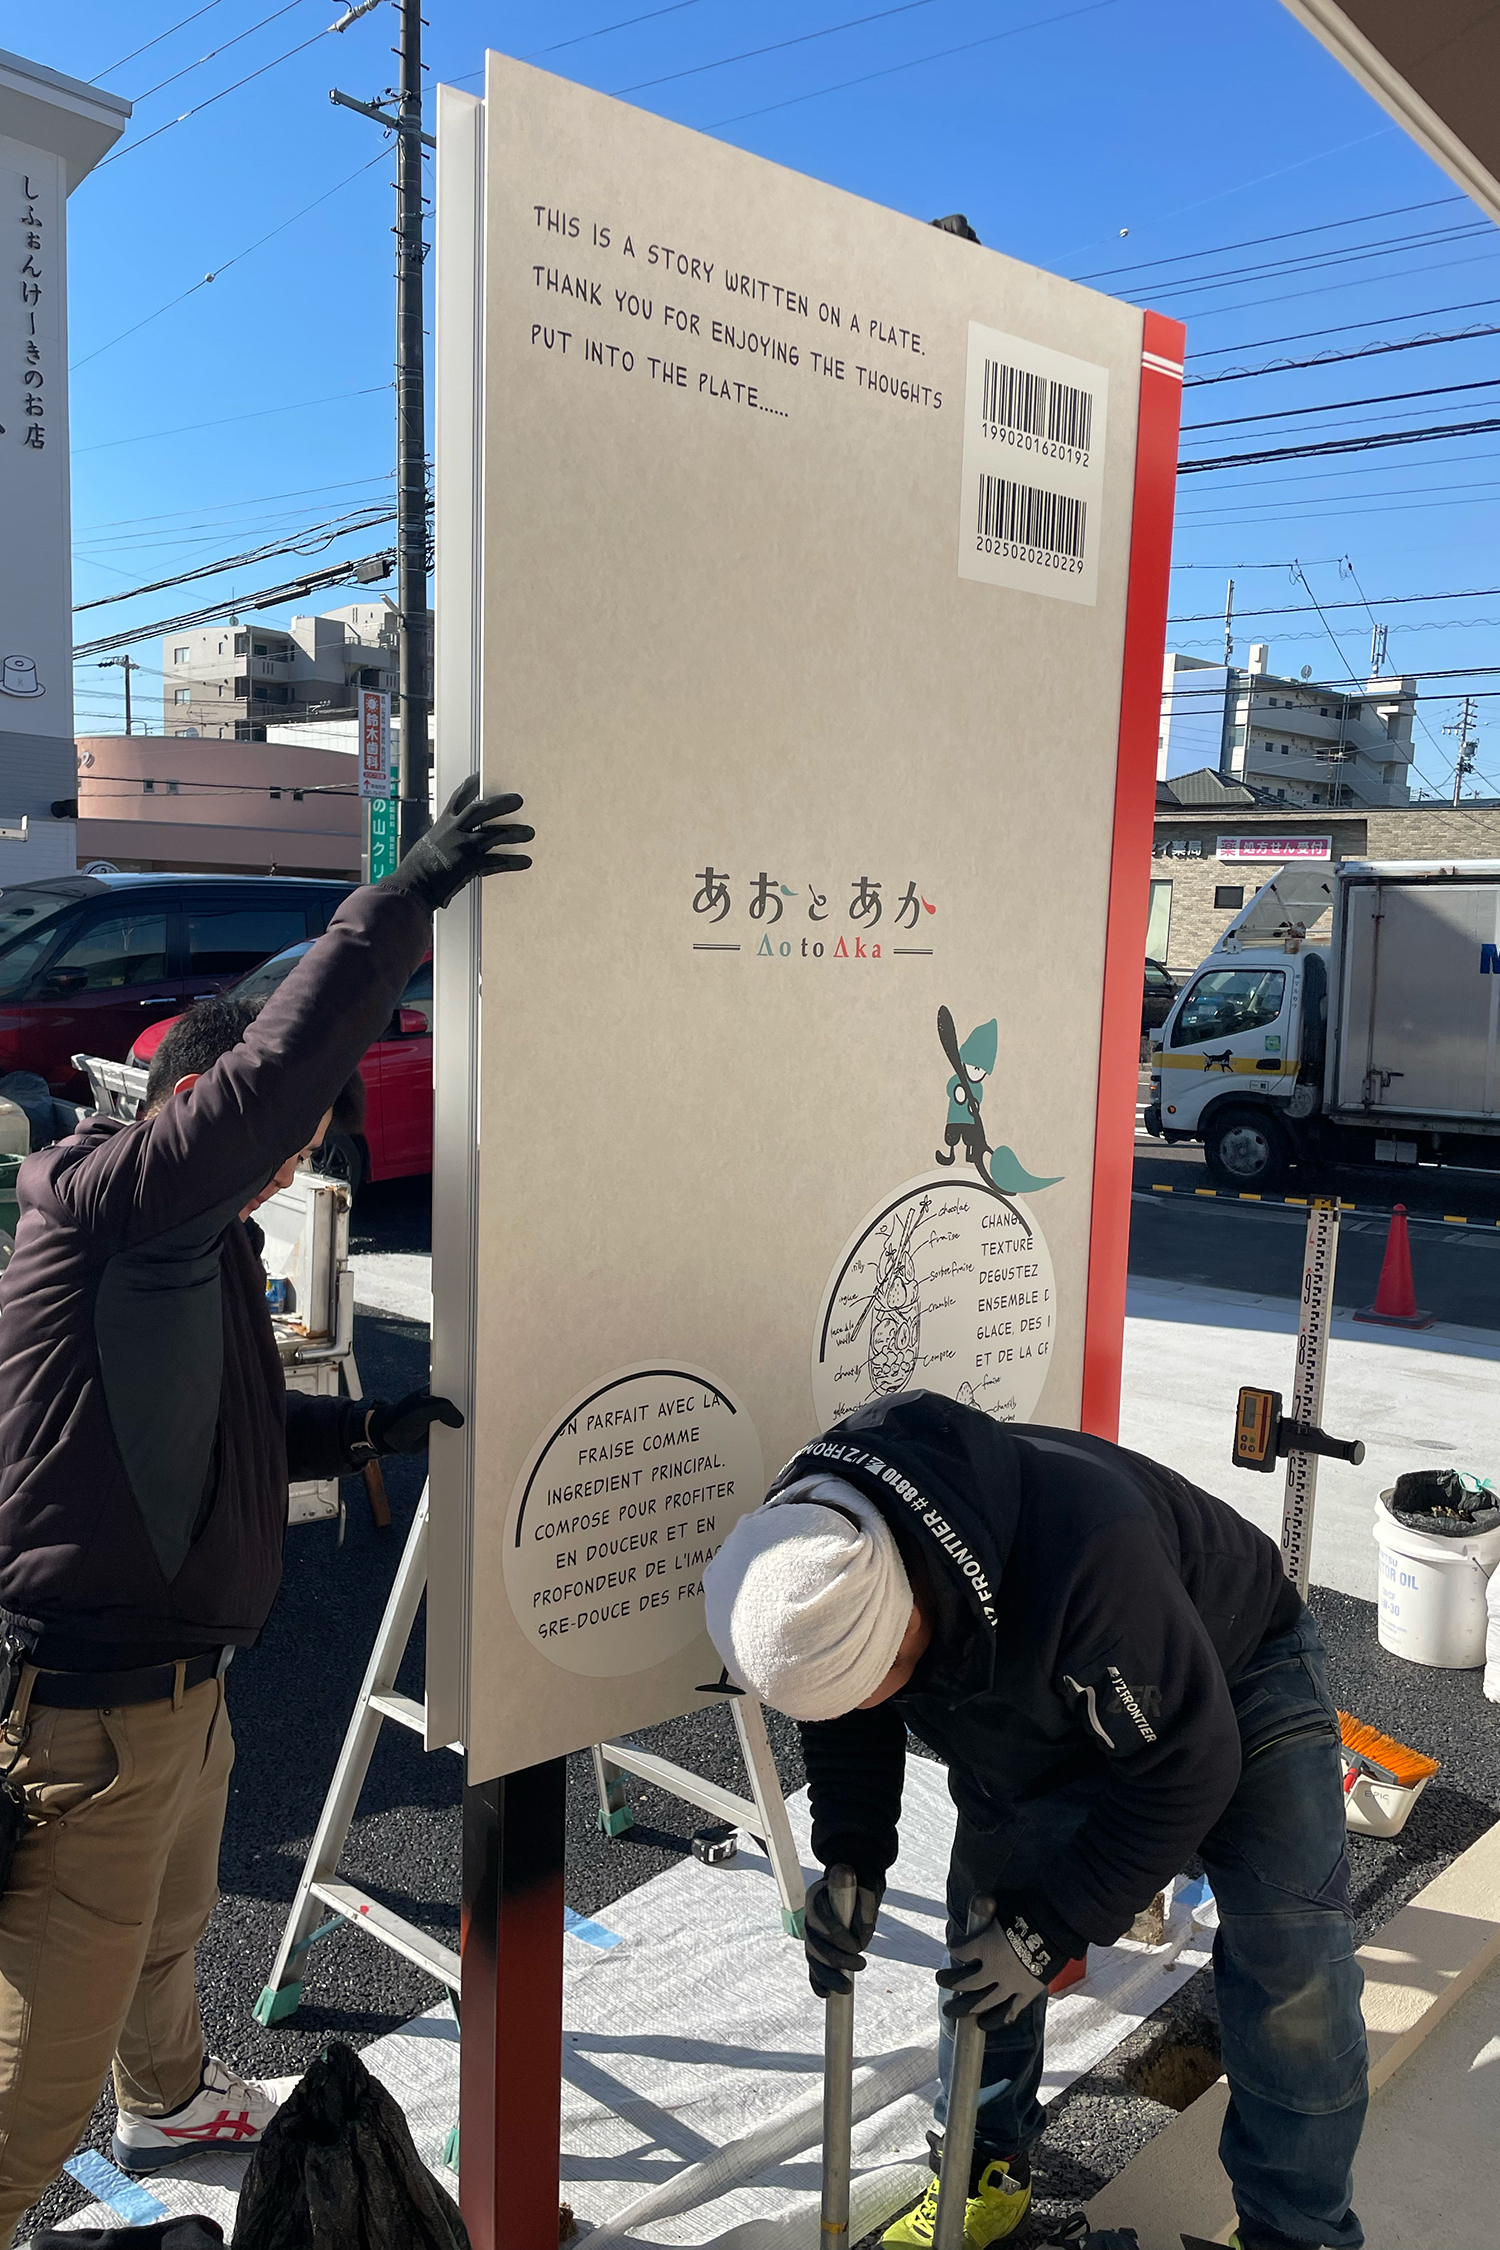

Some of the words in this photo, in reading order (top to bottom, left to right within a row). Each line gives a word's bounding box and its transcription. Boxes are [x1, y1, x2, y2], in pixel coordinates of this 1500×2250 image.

[533, 205, 581, 238] THIS
[592, 223, 611, 249] IS
[623, 235, 636, 258] A
[647, 244, 715, 284] STORY
[724, 268, 808, 317] WRITTEN
[818, 301, 841, 328] ON
[849, 313, 860, 333] A
[869, 319, 926, 356] PLATE.
[531, 324, 572, 354] PUT
[585, 337, 634, 372] INTO
[647, 356, 687, 388] THE
[532, 265, 602, 306] THANK
[614, 289, 653, 320] YOU
[664, 305, 700, 336] FOR
[712, 320, 800, 366] ENJOYING
[810, 351, 845, 381] THE
[855, 365, 944, 410] THOUGHTS
[982, 422, 1090, 468] 1990201620192
[976, 536, 1084, 574] 2025020220229
[366, 712, 379, 770] 鈴木歯科
[1220, 839, 1238, 857] 薬
[1243, 841, 1324, 855] 処方せん受付
[692, 866, 937, 930] あおとあか
[800, 936, 825, 958] to
[981, 1237, 1034, 1257] TEXTURE
[979, 1263, 1039, 1285] DEGUSTEZ
[978, 1290, 1038, 1313] ENSEMBLE
[1020, 1316, 1042, 1333] DES
[975, 1352, 992, 1368] ET
[998, 1348, 1014, 1364] DE
[1019, 1345, 1032, 1359] LA
[1298, 1334, 1306, 1365] 8
[586, 1404, 649, 1431] PARFAIT
[657, 1396, 695, 1418] AVEC
[703, 1393, 721, 1409] LA
[578, 1440, 634, 1466] FRAISE
[643, 1427, 700, 1452] COMME
[547, 1469, 643, 1506] INGREDIENT
[651, 1453, 726, 1483] PRINCIPAL.
[1288, 1456, 1296, 1487] 6
[534, 1510, 610, 1542] COMPOSE
[618, 1499, 657, 1522] POUR
[664, 1480, 735, 1511] PROFITER
[556, 1549, 577, 1570] EN
[586, 1530, 659, 1563] DOUCEUR
[666, 1522, 688, 1542] ET
[697, 1515, 715, 1535] EN
[1283, 1517, 1291, 1549] 5
[922, 1508, 993, 1603] FRONTIER
[532, 1567, 637, 1609] PROFONDEUR
[645, 1559, 666, 1580] DE
[1399, 1572, 1419, 1590] OIL
[639, 1589, 670, 1612] DES
